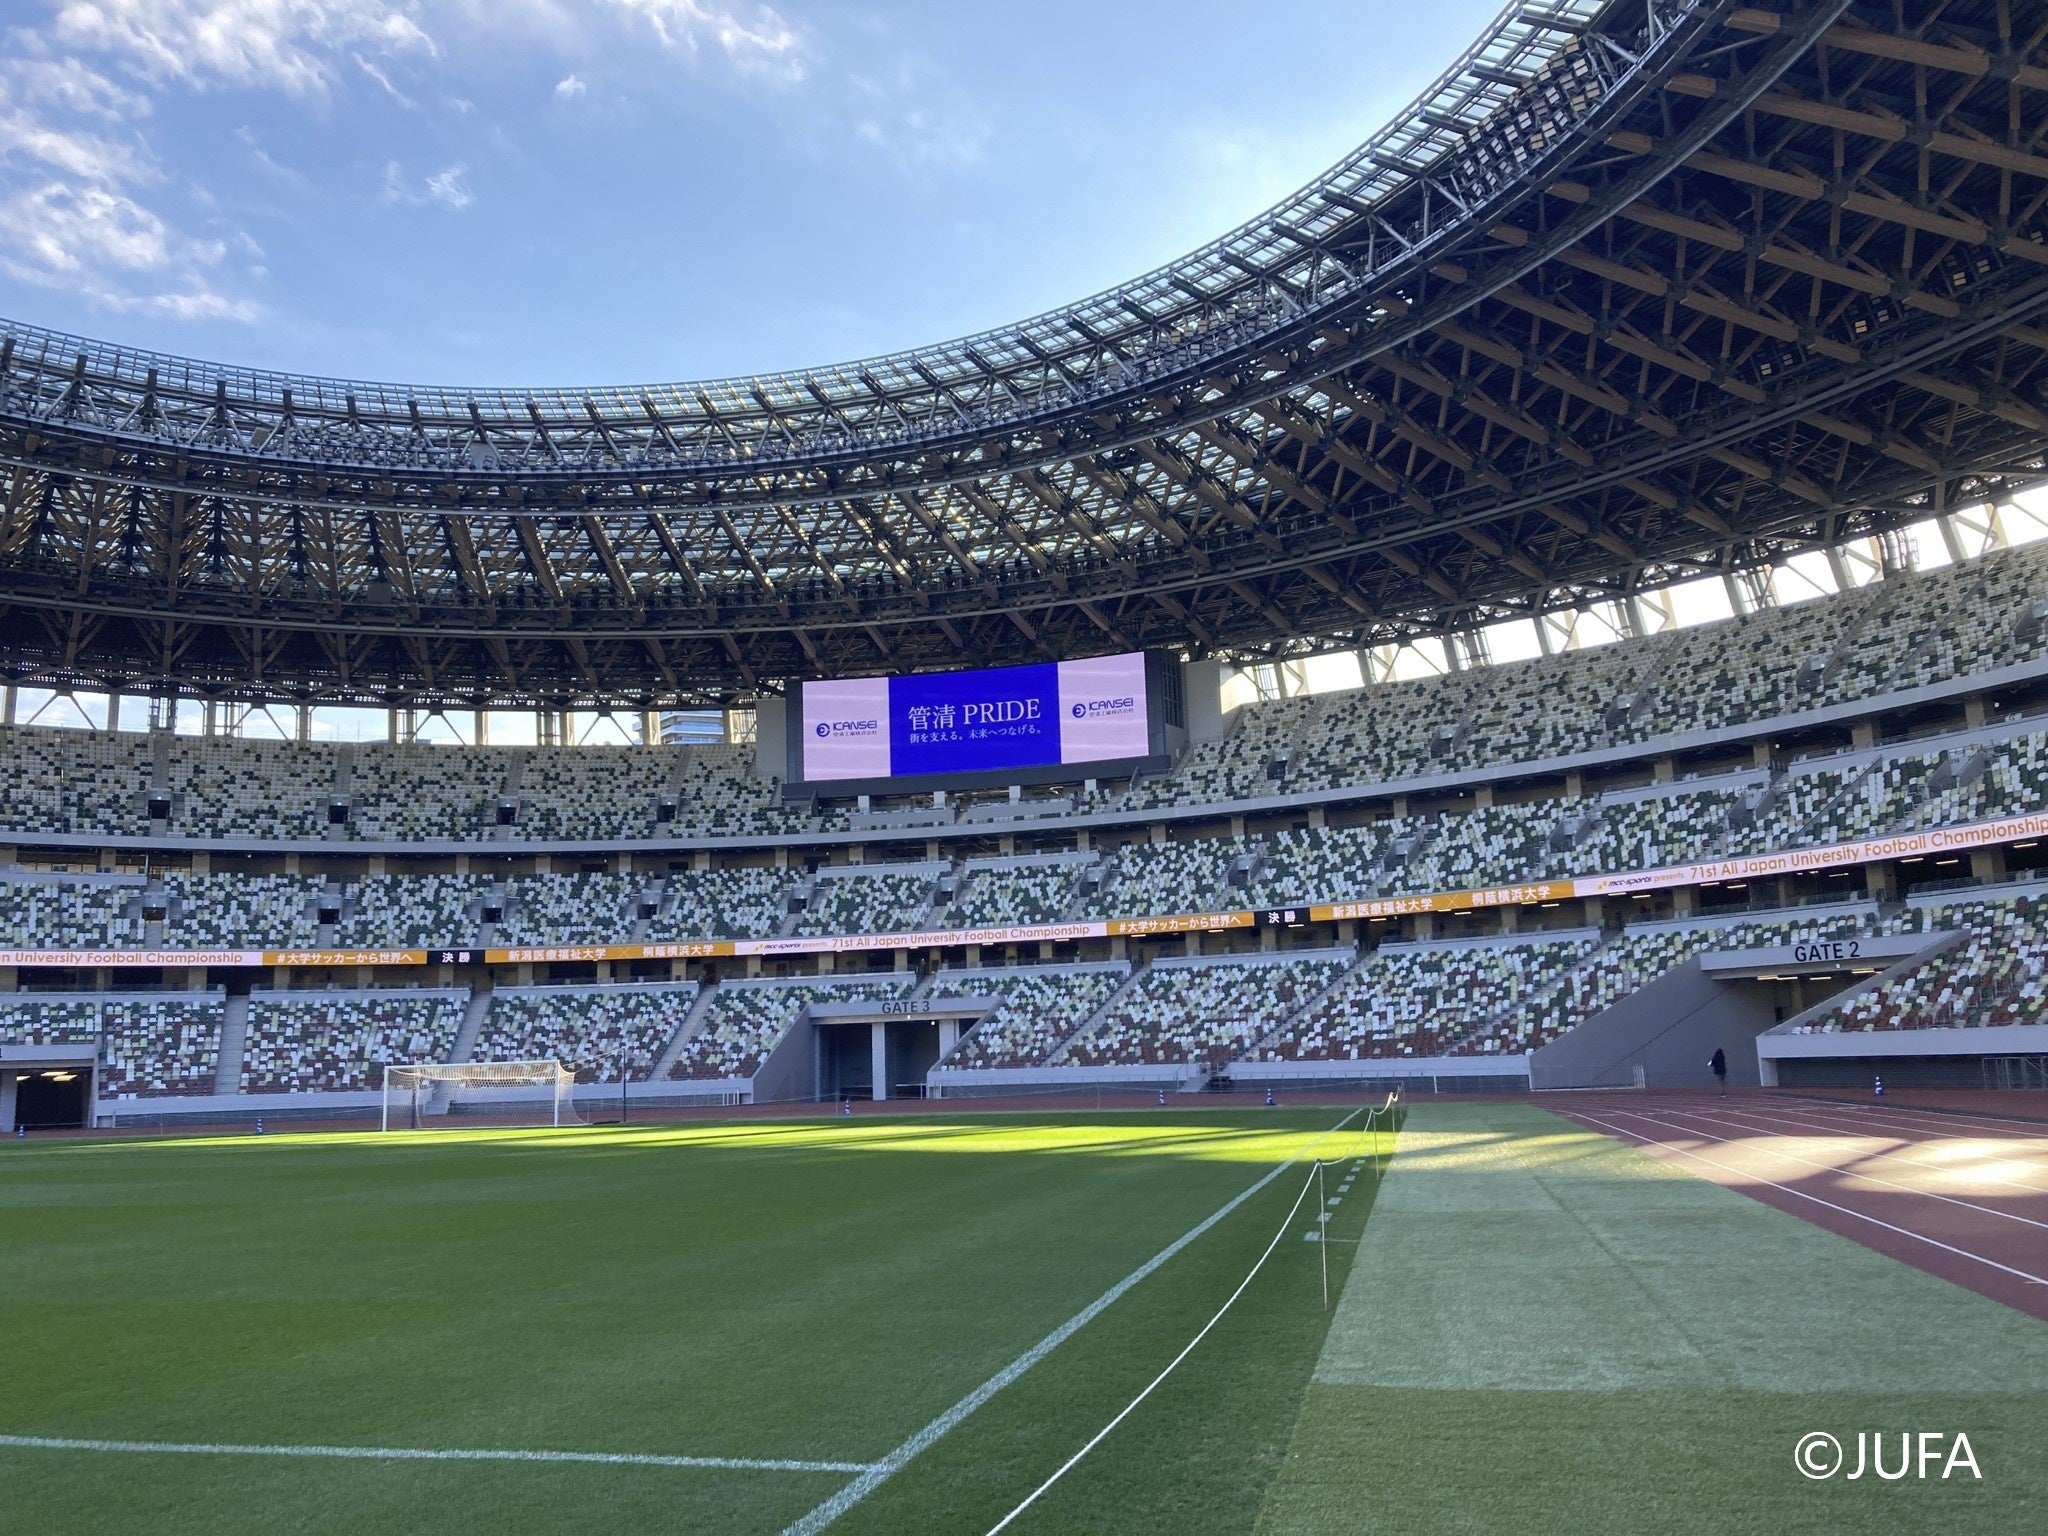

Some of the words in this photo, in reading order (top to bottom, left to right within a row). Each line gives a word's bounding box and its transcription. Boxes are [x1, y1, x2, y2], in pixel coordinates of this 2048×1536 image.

[1089, 697, 1134, 711] KANSEI
[908, 704, 956, 731] 管清
[962, 698, 1041, 725] PRIDE
[833, 720, 878, 731] KANSEI
[1654, 872, 1684, 883] presents
[1690, 866, 1717, 879] 71st
[1721, 862, 1738, 876] All
[1742, 856, 1787, 874] Japan
[1792, 844, 1860, 867] University
[1865, 835, 1926, 856] Football
[802, 941, 827, 949] presents
[833, 938, 853, 948] 71st
[857, 937, 870, 947] All
[873, 936, 907, 948] Japan
[910, 932, 961, 944] University
[965, 929, 1007, 941] Football
[1010, 925, 1090, 940] Championship
[15, 952, 83, 965] University
[87, 952, 141, 963] Football
[146, 952, 243, 965] Championship
[1795, 943, 1844, 962] GATE
[1849, 941, 1860, 958] 2
[882, 1001, 918, 1014] GATE
[922, 1000, 930, 1012] 3
